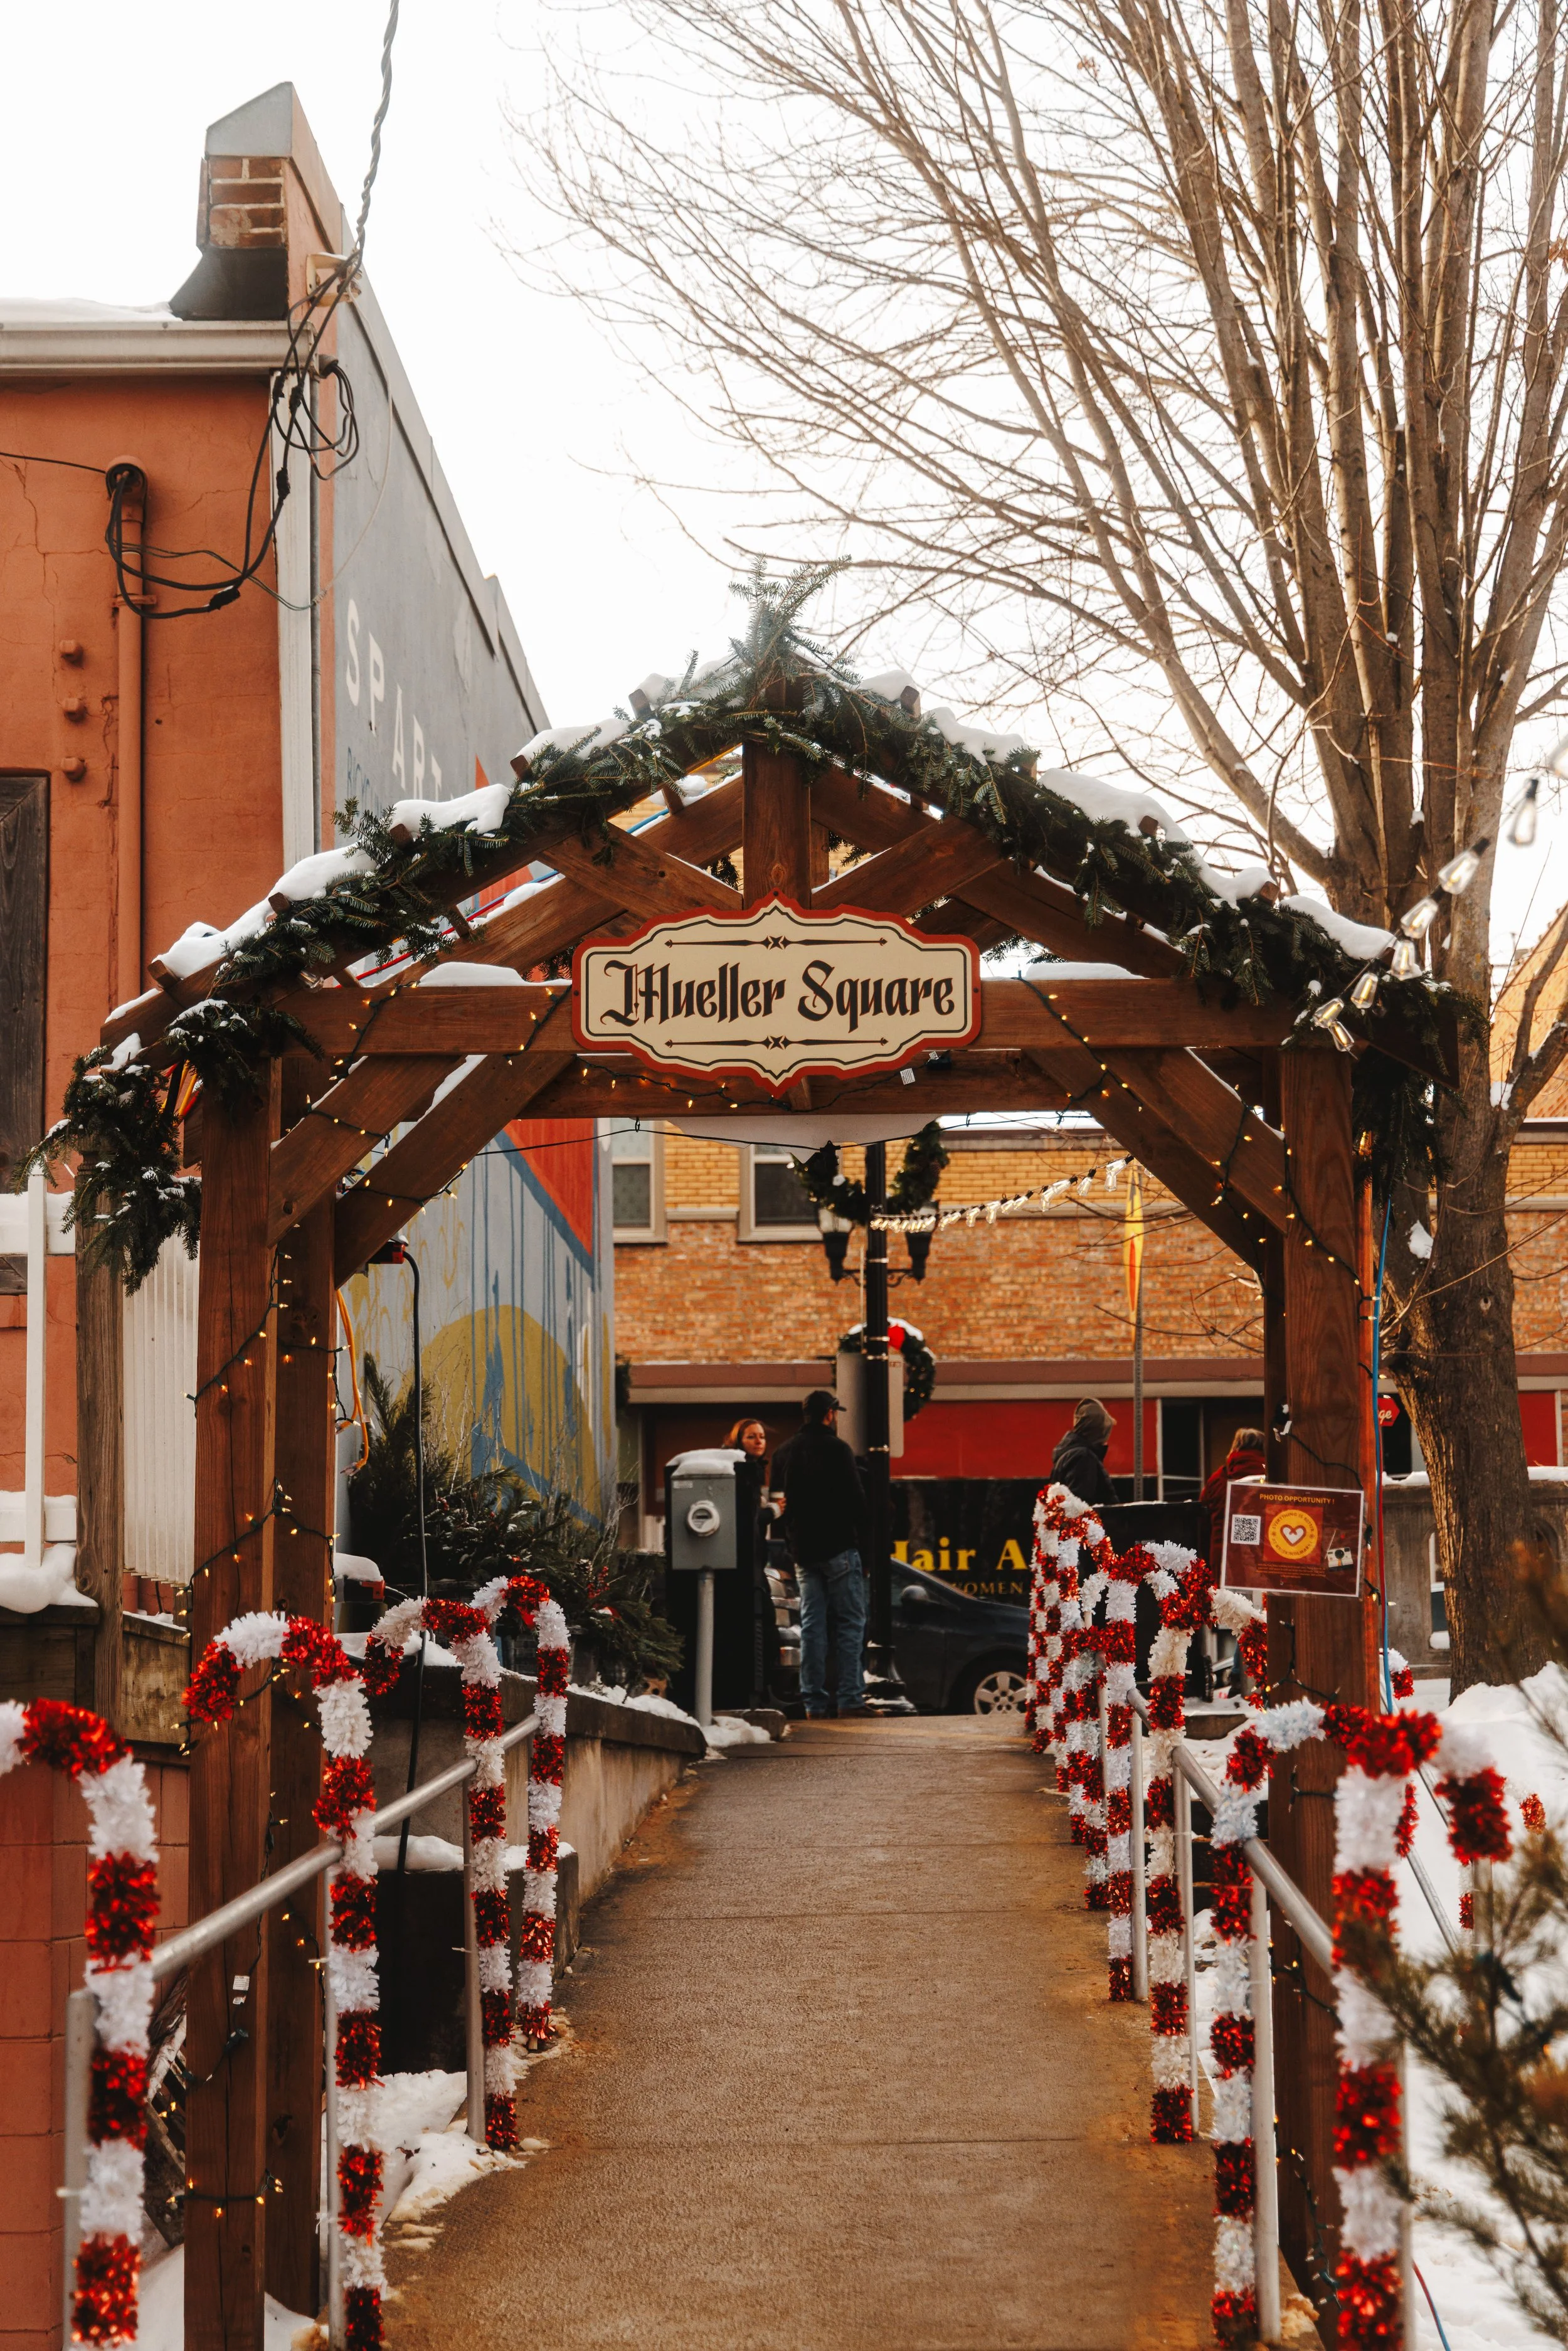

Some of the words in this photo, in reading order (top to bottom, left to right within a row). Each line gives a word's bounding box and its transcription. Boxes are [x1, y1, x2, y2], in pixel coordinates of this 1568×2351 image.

[346, 598, 454, 802] SPART
[600, 960, 785, 1027] Mueller
[797, 960, 955, 1034] Square
[1284, 1495, 1331, 1504] OPPORTUNITY
